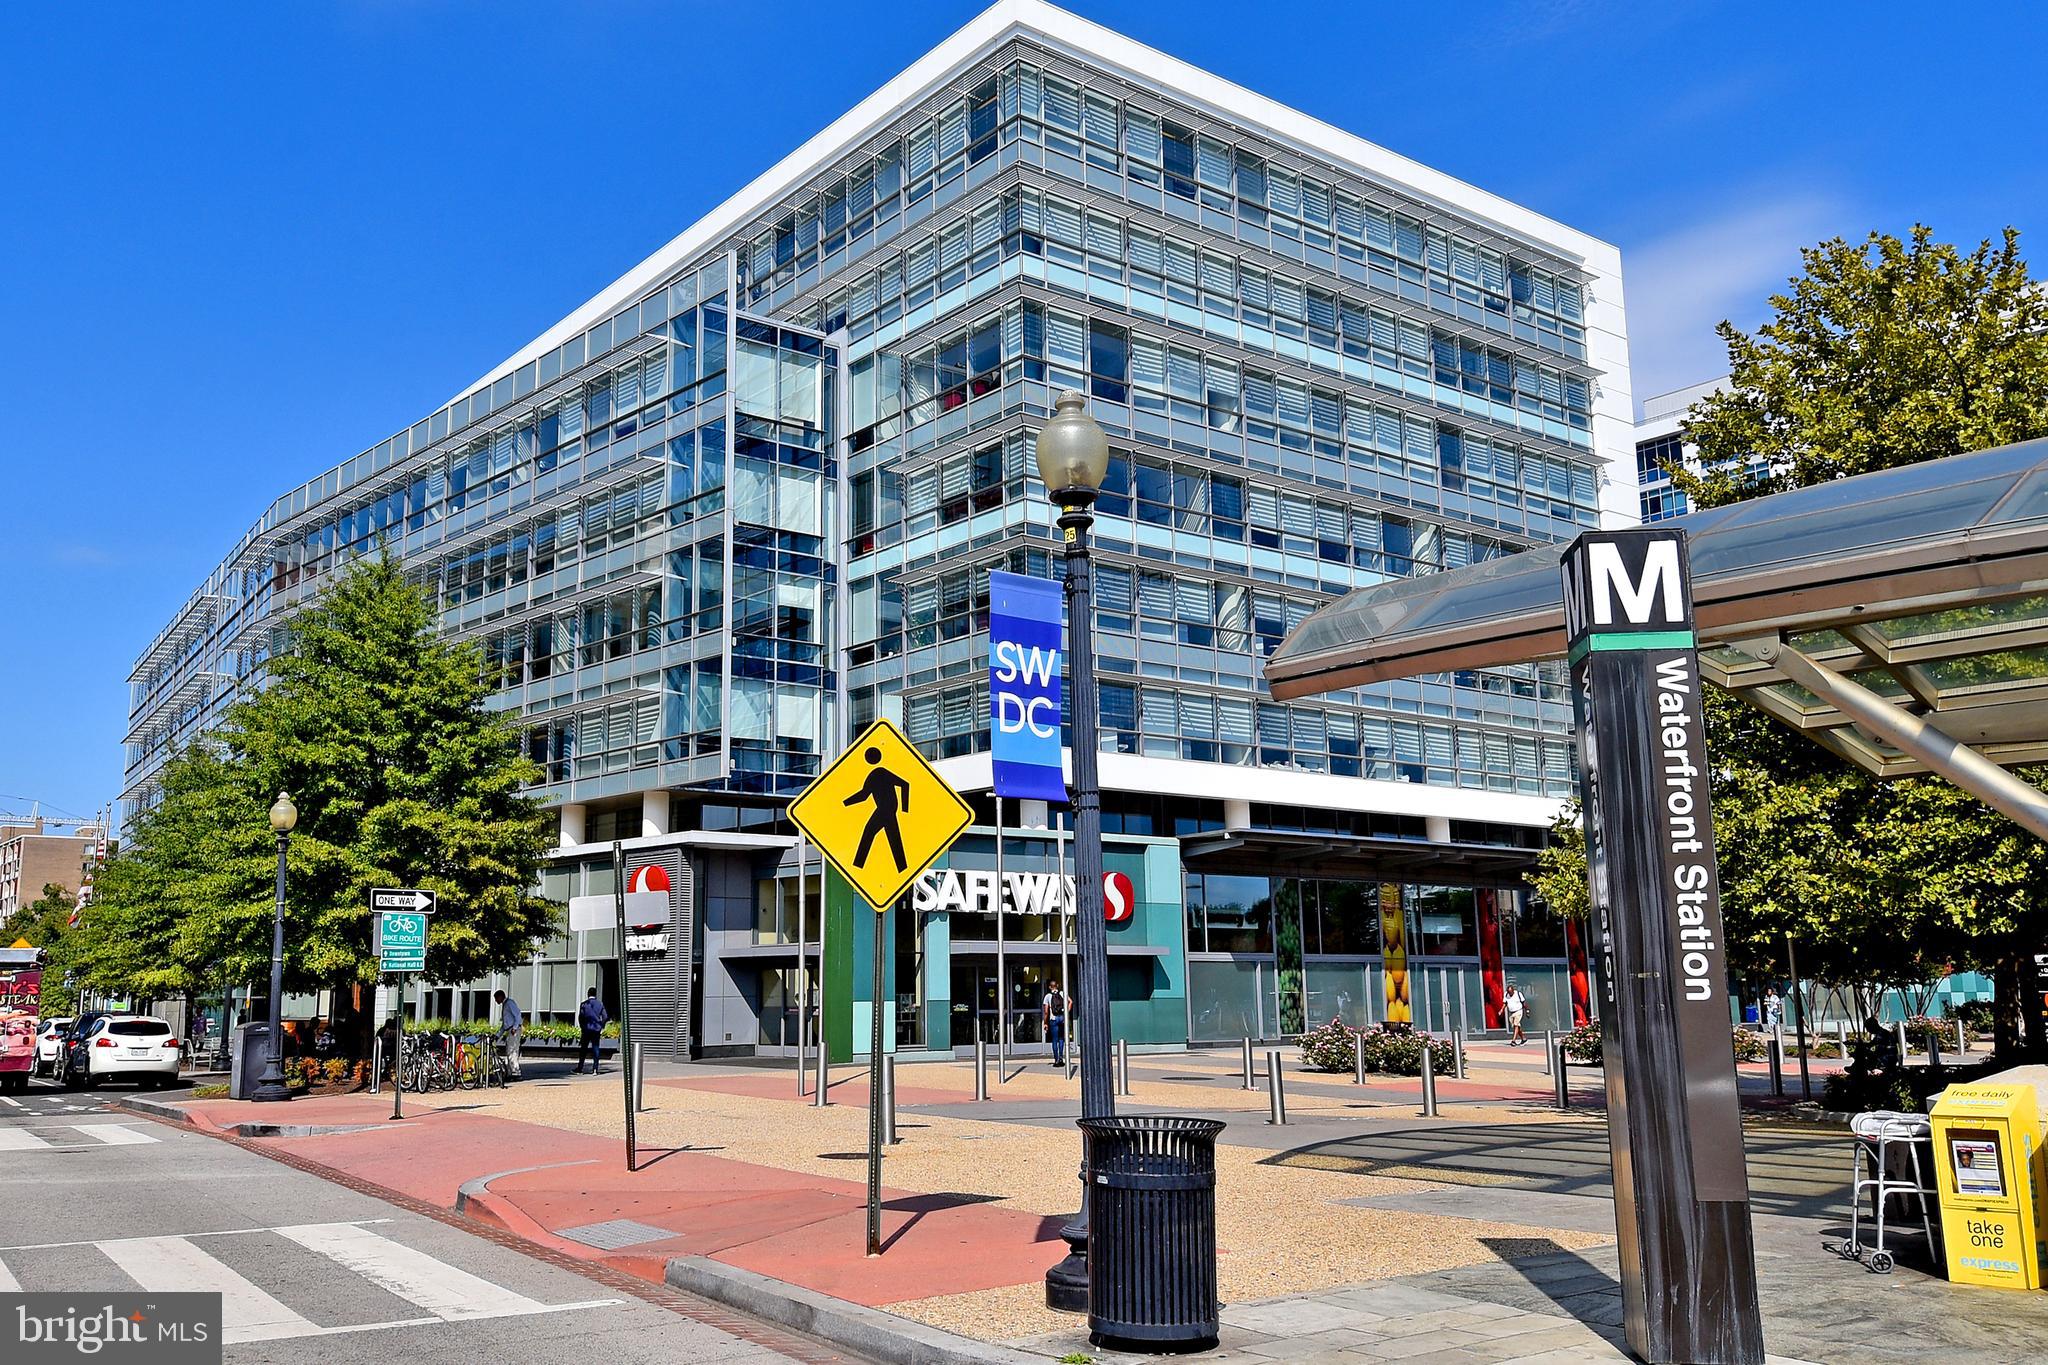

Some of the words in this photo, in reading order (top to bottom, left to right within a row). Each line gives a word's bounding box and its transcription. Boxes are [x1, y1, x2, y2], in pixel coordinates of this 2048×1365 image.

[1561, 547, 1587, 642] M
[1588, 540, 1684, 624] M
[996, 640, 1056, 687] SW
[998, 691, 1054, 739] DC
[1656, 656, 1703, 854] Waterfront
[378, 895, 396, 905] ONE
[398, 896, 416, 906] WAY
[383, 934, 399, 942] BIKE
[399, 935, 422, 943] ROUTE
[1674, 864, 1715, 1002] Station
[1951, 1090, 1978, 1098] free
[1981, 1091, 2015, 1099] daily
[1967, 1219, 2004, 1236] take
[1971, 1235, 2004, 1249] one
[1960, 1257, 2019, 1272] express
